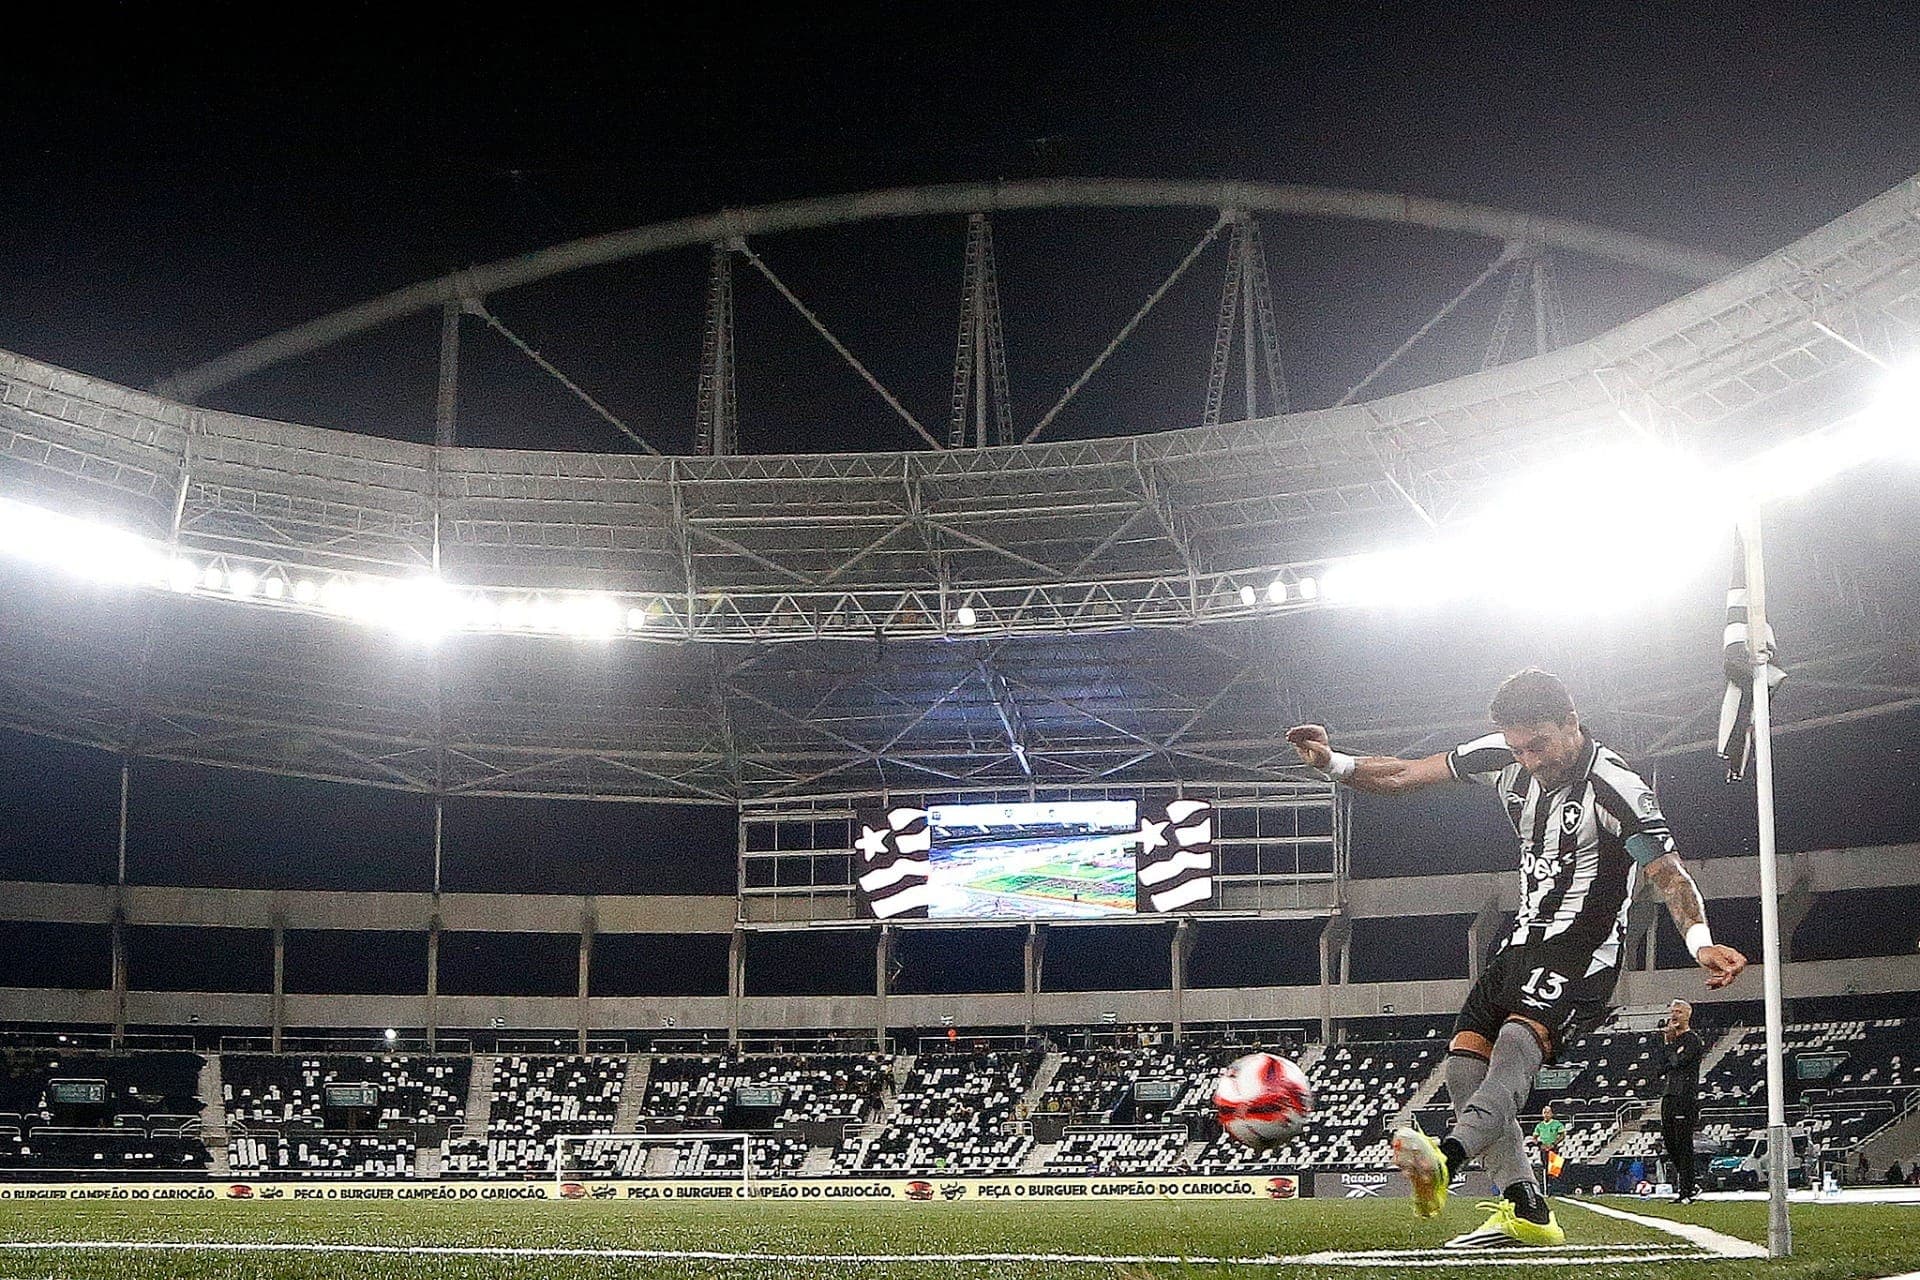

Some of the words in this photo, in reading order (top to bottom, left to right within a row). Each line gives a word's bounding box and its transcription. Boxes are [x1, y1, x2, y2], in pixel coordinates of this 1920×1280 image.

[1521, 967, 1569, 1000] 13
[1341, 1173, 1388, 1184] Reebok
[1, 1190, 11, 1199] O
[131, 1190, 150, 1199] DO
[327, 1188, 338, 1199] O
[340, 1188, 394, 1199] BURGUER
[397, 1185, 457, 1199] CAMPEÃO
[459, 1188, 478, 1199] DO
[627, 1187, 660, 1200] PEÇA
[662, 1187, 673, 1198] O
[676, 1186, 733, 1198] BURGUER
[801, 1186, 821, 1198] DO
[978, 1185, 1012, 1199] PEÇA
[1014, 1184, 1026, 1196] O
[1028, 1184, 1088, 1196] BURGUER
[1091, 1180, 1155, 1196] CAMPEÃO
[1159, 1183, 1179, 1195] DO
